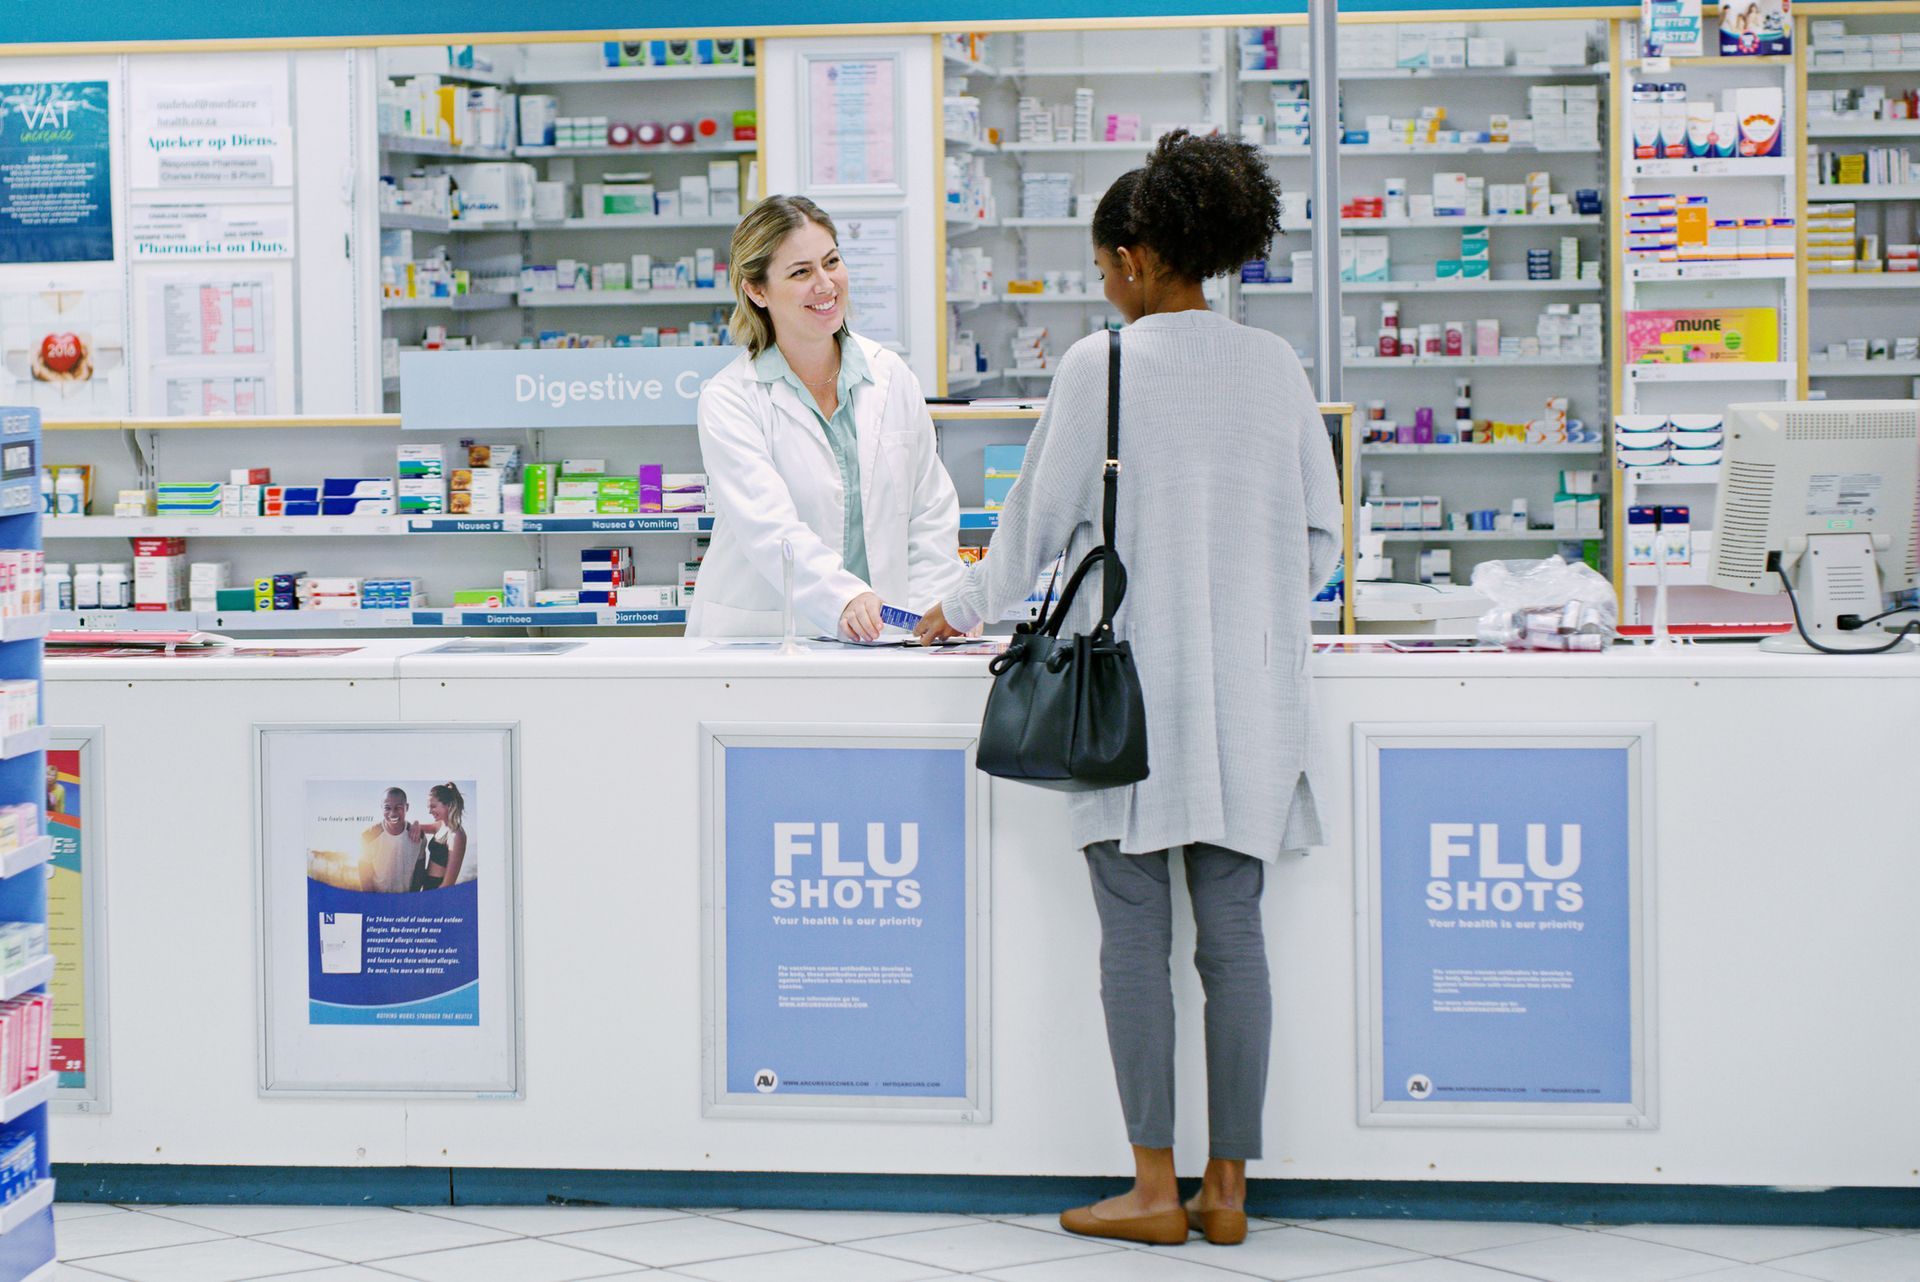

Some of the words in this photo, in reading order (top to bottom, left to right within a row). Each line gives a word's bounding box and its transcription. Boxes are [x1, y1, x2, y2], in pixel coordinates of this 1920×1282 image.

[1656, 5, 1679, 14] FEEL
[1654, 17, 1691, 27] BETTER
[1653, 31, 1695, 43] FASTER
[20, 102, 69, 130] VAT
[20, 130, 74, 143] increase
[148, 135, 203, 152] Apteker
[208, 139, 226, 151] op
[140, 241, 222, 254] Pharmacist
[226, 244, 245, 253] on
[515, 373, 663, 408] Digestive
[457, 522, 490, 530] Nausea
[592, 521, 626, 529] Nausea
[629, 520, 635, 529] &
[638, 520, 679, 530] Vomiting
[487, 614, 532, 624] Diarrhoea
[773, 821, 919, 878] FLU
[1430, 822, 1582, 880] FLU
[770, 879, 922, 909] SHOTS
[1425, 880, 1584, 912] SHOTS
[326, 914, 334, 922] N
[773, 916, 799, 925] Your
[802, 916, 839, 925] health
[843, 916, 853, 925] is
[857, 917, 876, 925] our
[879, 916, 923, 927] priority
[1428, 919, 1456, 928] Your
[1459, 919, 1498, 929] health
[1501, 919, 1512, 929] is
[1516, 921, 1535, 929] our
[1538, 920, 1585, 931] priority
[757, 1075, 775, 1087] AV
[1410, 1081, 1428, 1092] AV
